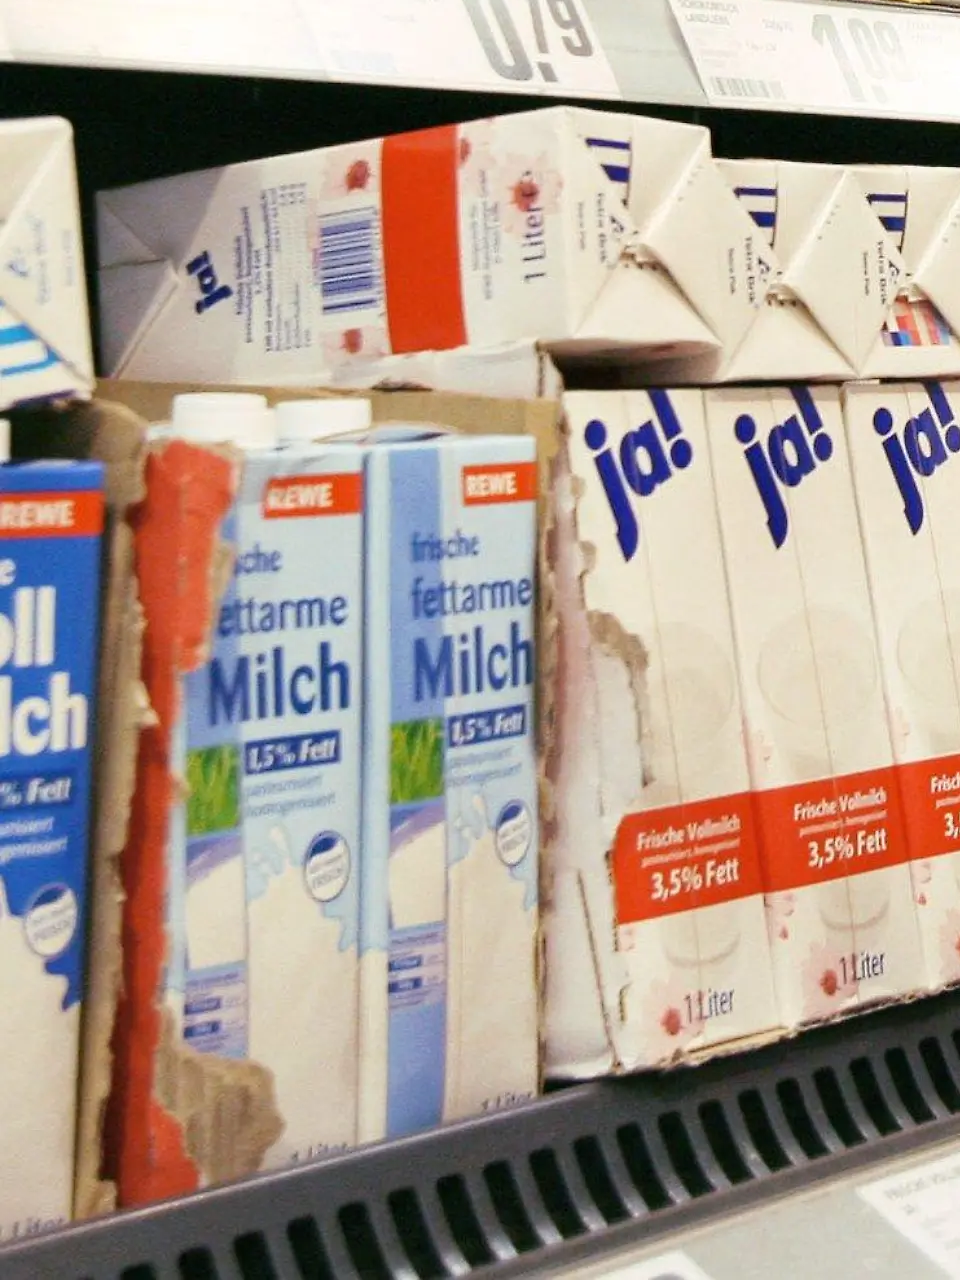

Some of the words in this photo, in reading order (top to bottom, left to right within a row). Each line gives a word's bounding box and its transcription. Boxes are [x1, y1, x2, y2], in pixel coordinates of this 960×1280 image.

[517, 205, 547, 266] Liter
[522, 270, 547, 284] 1
[468, 472, 518, 498] REWE
[582, 388, 694, 562] ja!
[733, 386, 834, 550] ja!
[267, 482, 334, 510] REWE
[410, 527, 481, 562] frische
[217, 594, 349, 638] ettarme
[411, 577, 533, 620] fettarme
[411, 620, 535, 703] Milch
[207, 640, 351, 726] Milch
[0, 671, 88, 757] lch
[793, 800, 838, 821] Frische
[636, 828, 685, 852] Frische
[806, 835, 855, 869] 3,5%
[856, 827, 888, 857] Fett
[650, 866, 702, 901] 3,5%
[705, 858, 740, 888] Fett
[852, 950, 886, 982] Liter
[698, 987, 736, 1021] Liter
